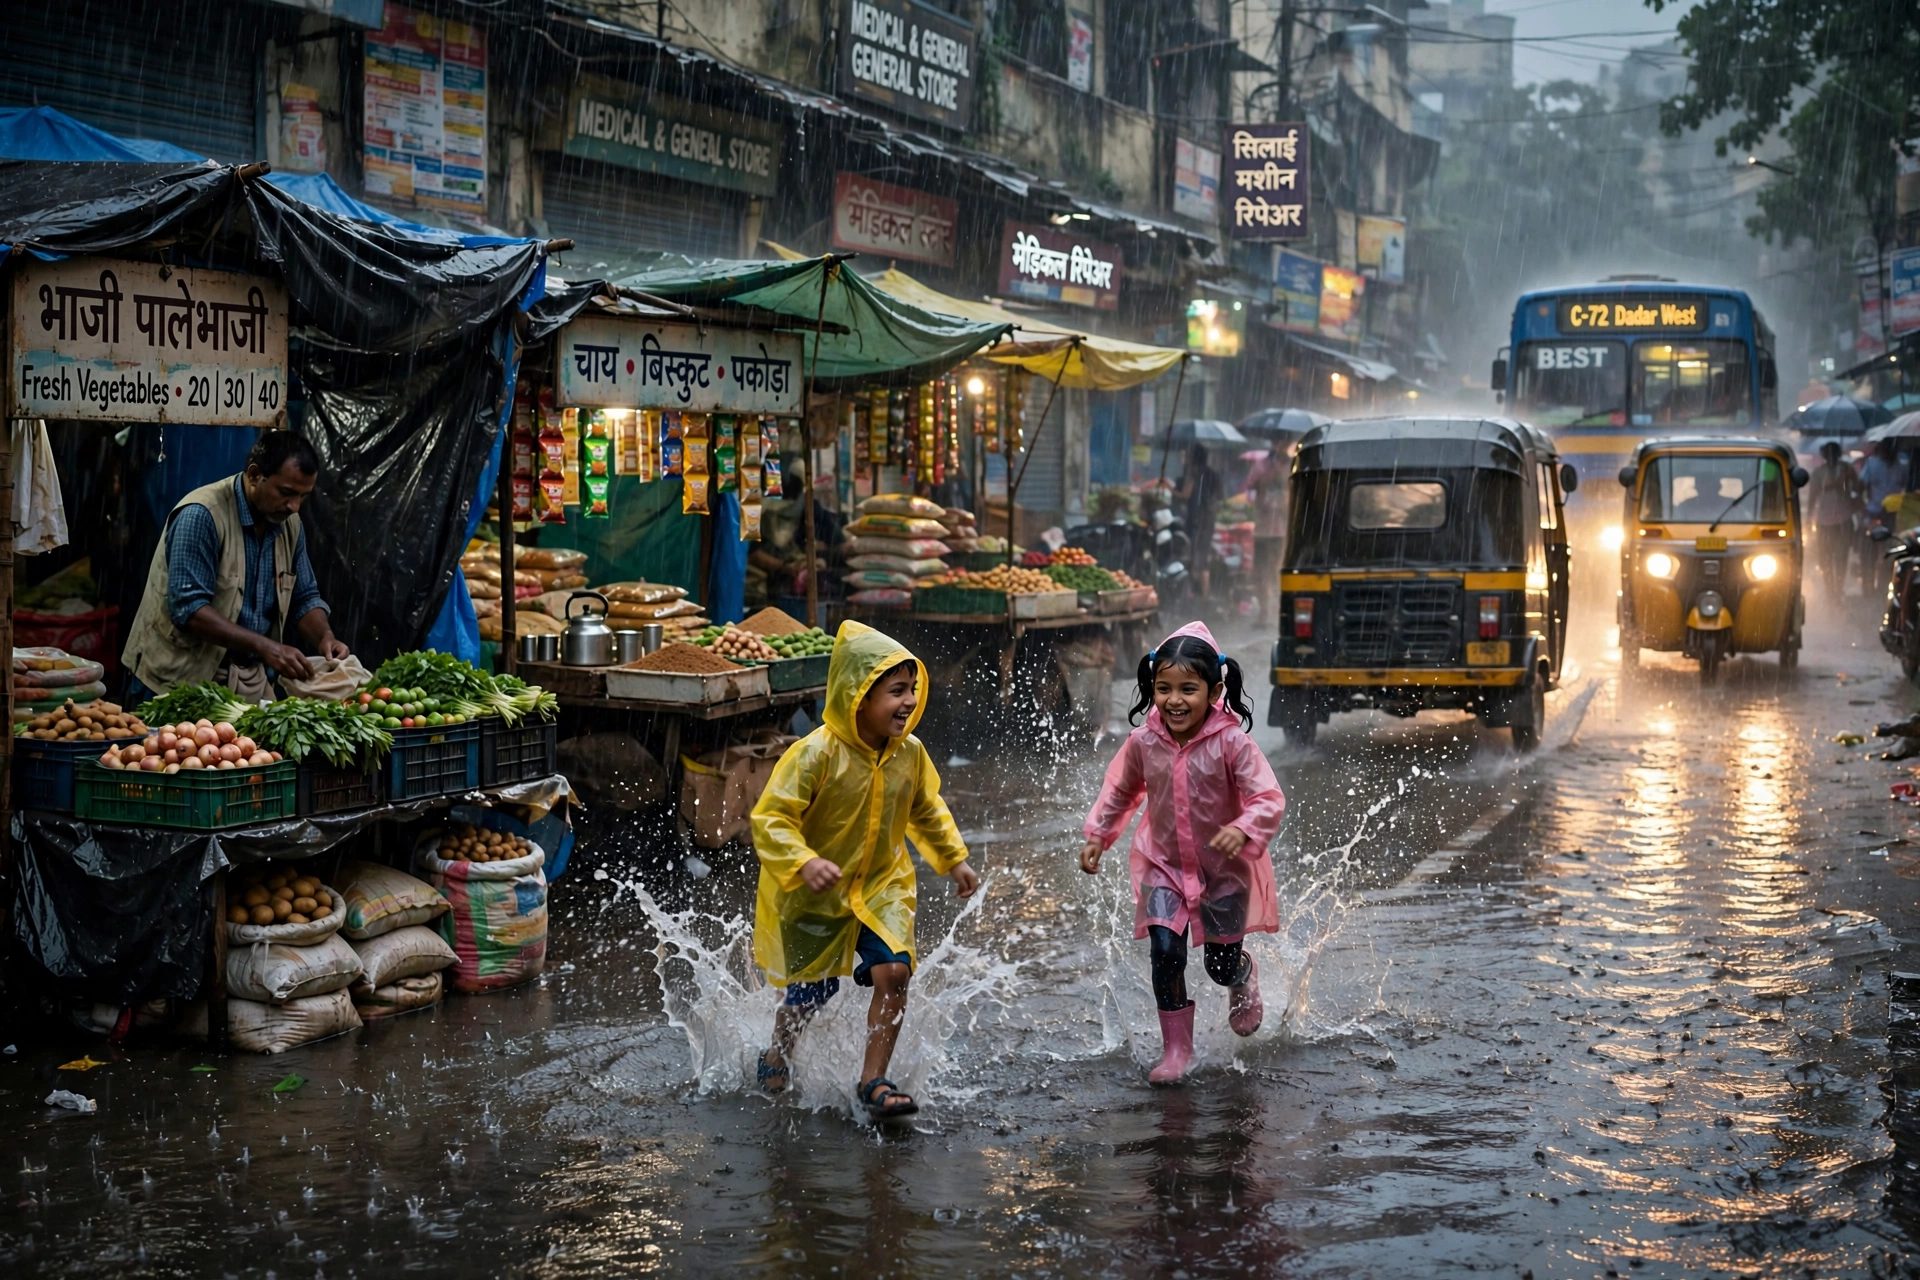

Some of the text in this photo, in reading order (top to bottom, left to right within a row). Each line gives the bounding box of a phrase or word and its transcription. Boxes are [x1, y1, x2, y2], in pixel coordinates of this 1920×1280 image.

[851, 0, 970, 78] MEDICAL & GENERAL
[852, 42, 958, 111] GENERAL STORE
[578, 100, 771, 177] MEDICAL & GENEAL STORE
[1232, 129, 1299, 162] सिलाई
[1234, 161, 1298, 192] मशीन
[1234, 196, 1304, 227] रिपेअर
[1070, 244, 1114, 290] रिपेअर
[39, 269, 123, 344] भाजी
[1570, 304, 1610, 327] C-72
[1614, 304, 1659, 326] Dadar
[1660, 303, 1697, 325] West
[573, 333, 792, 403] चाय बिस्कुट पकोड़ा
[1537, 347, 1608, 369] BEST
[21, 364, 71, 401] Fresh
[77, 367, 170, 412] Vegetables
